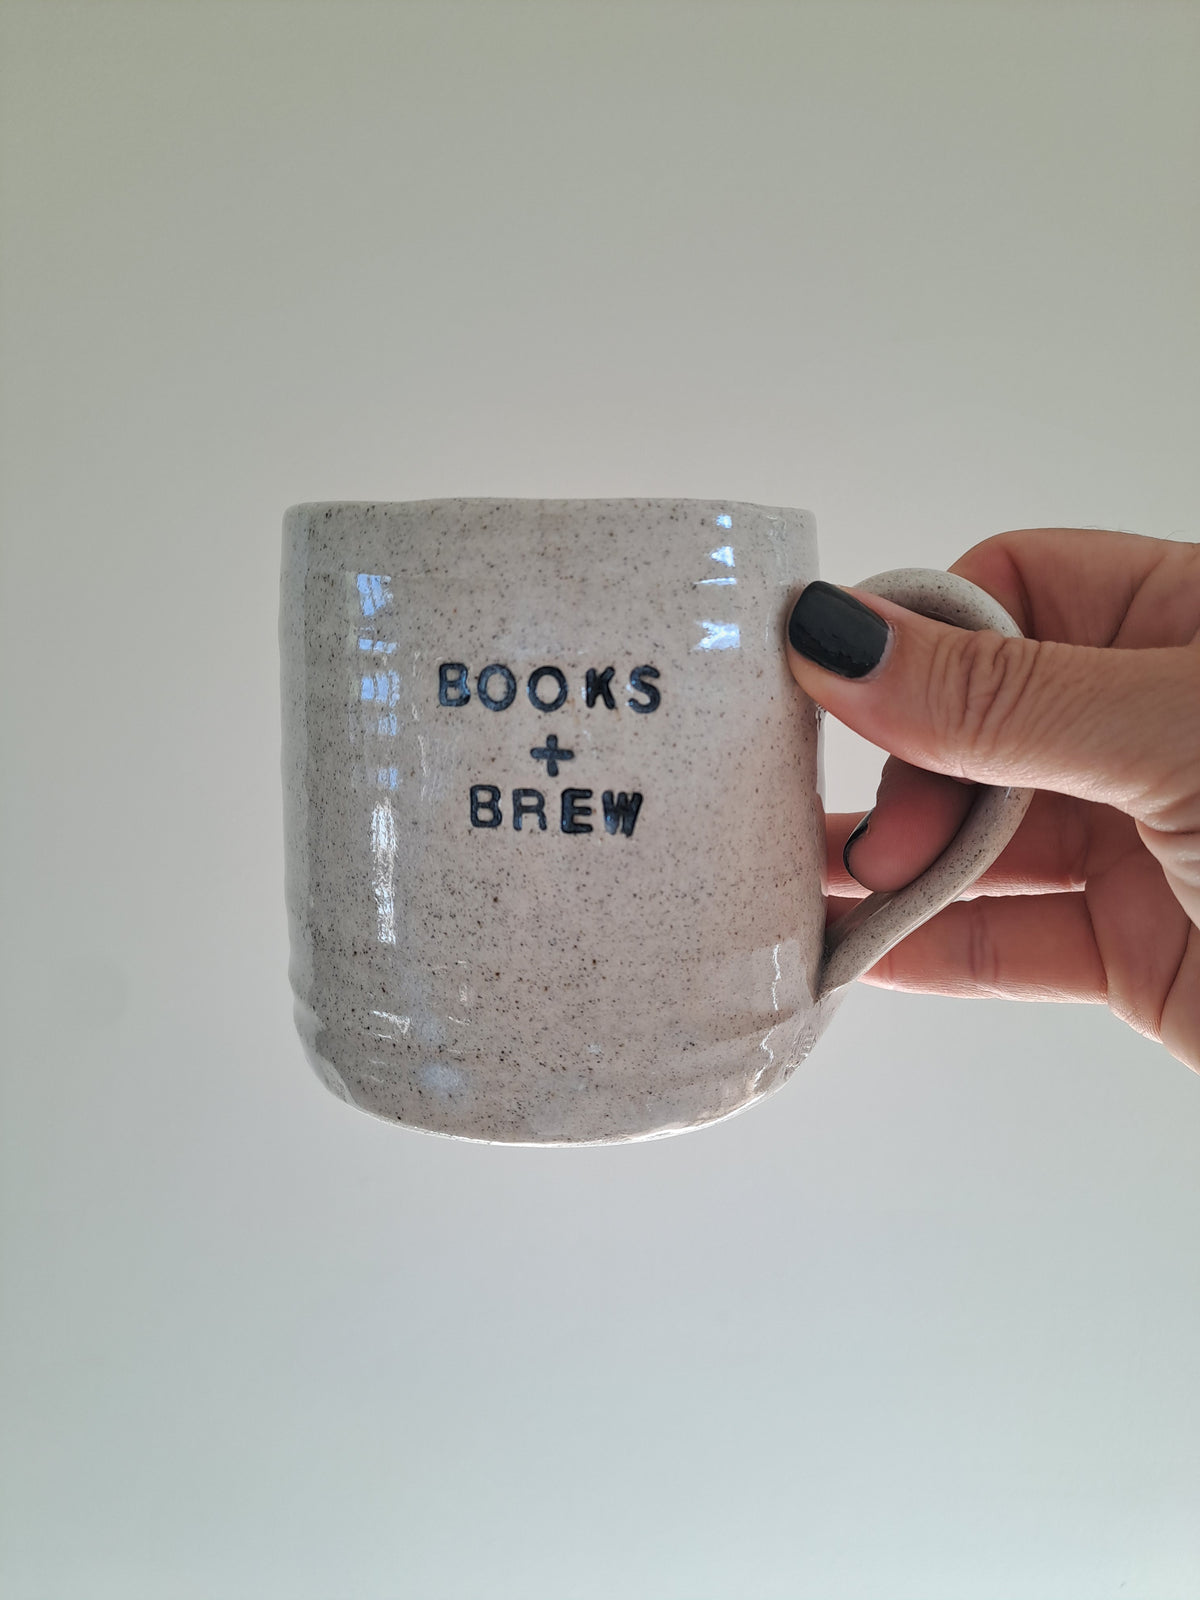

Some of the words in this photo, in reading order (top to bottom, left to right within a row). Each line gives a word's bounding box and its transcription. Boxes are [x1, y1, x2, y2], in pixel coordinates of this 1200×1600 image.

[438, 662, 661, 714] BOOKS
[529, 734, 575, 778] +
[469, 784, 644, 838] BREW
